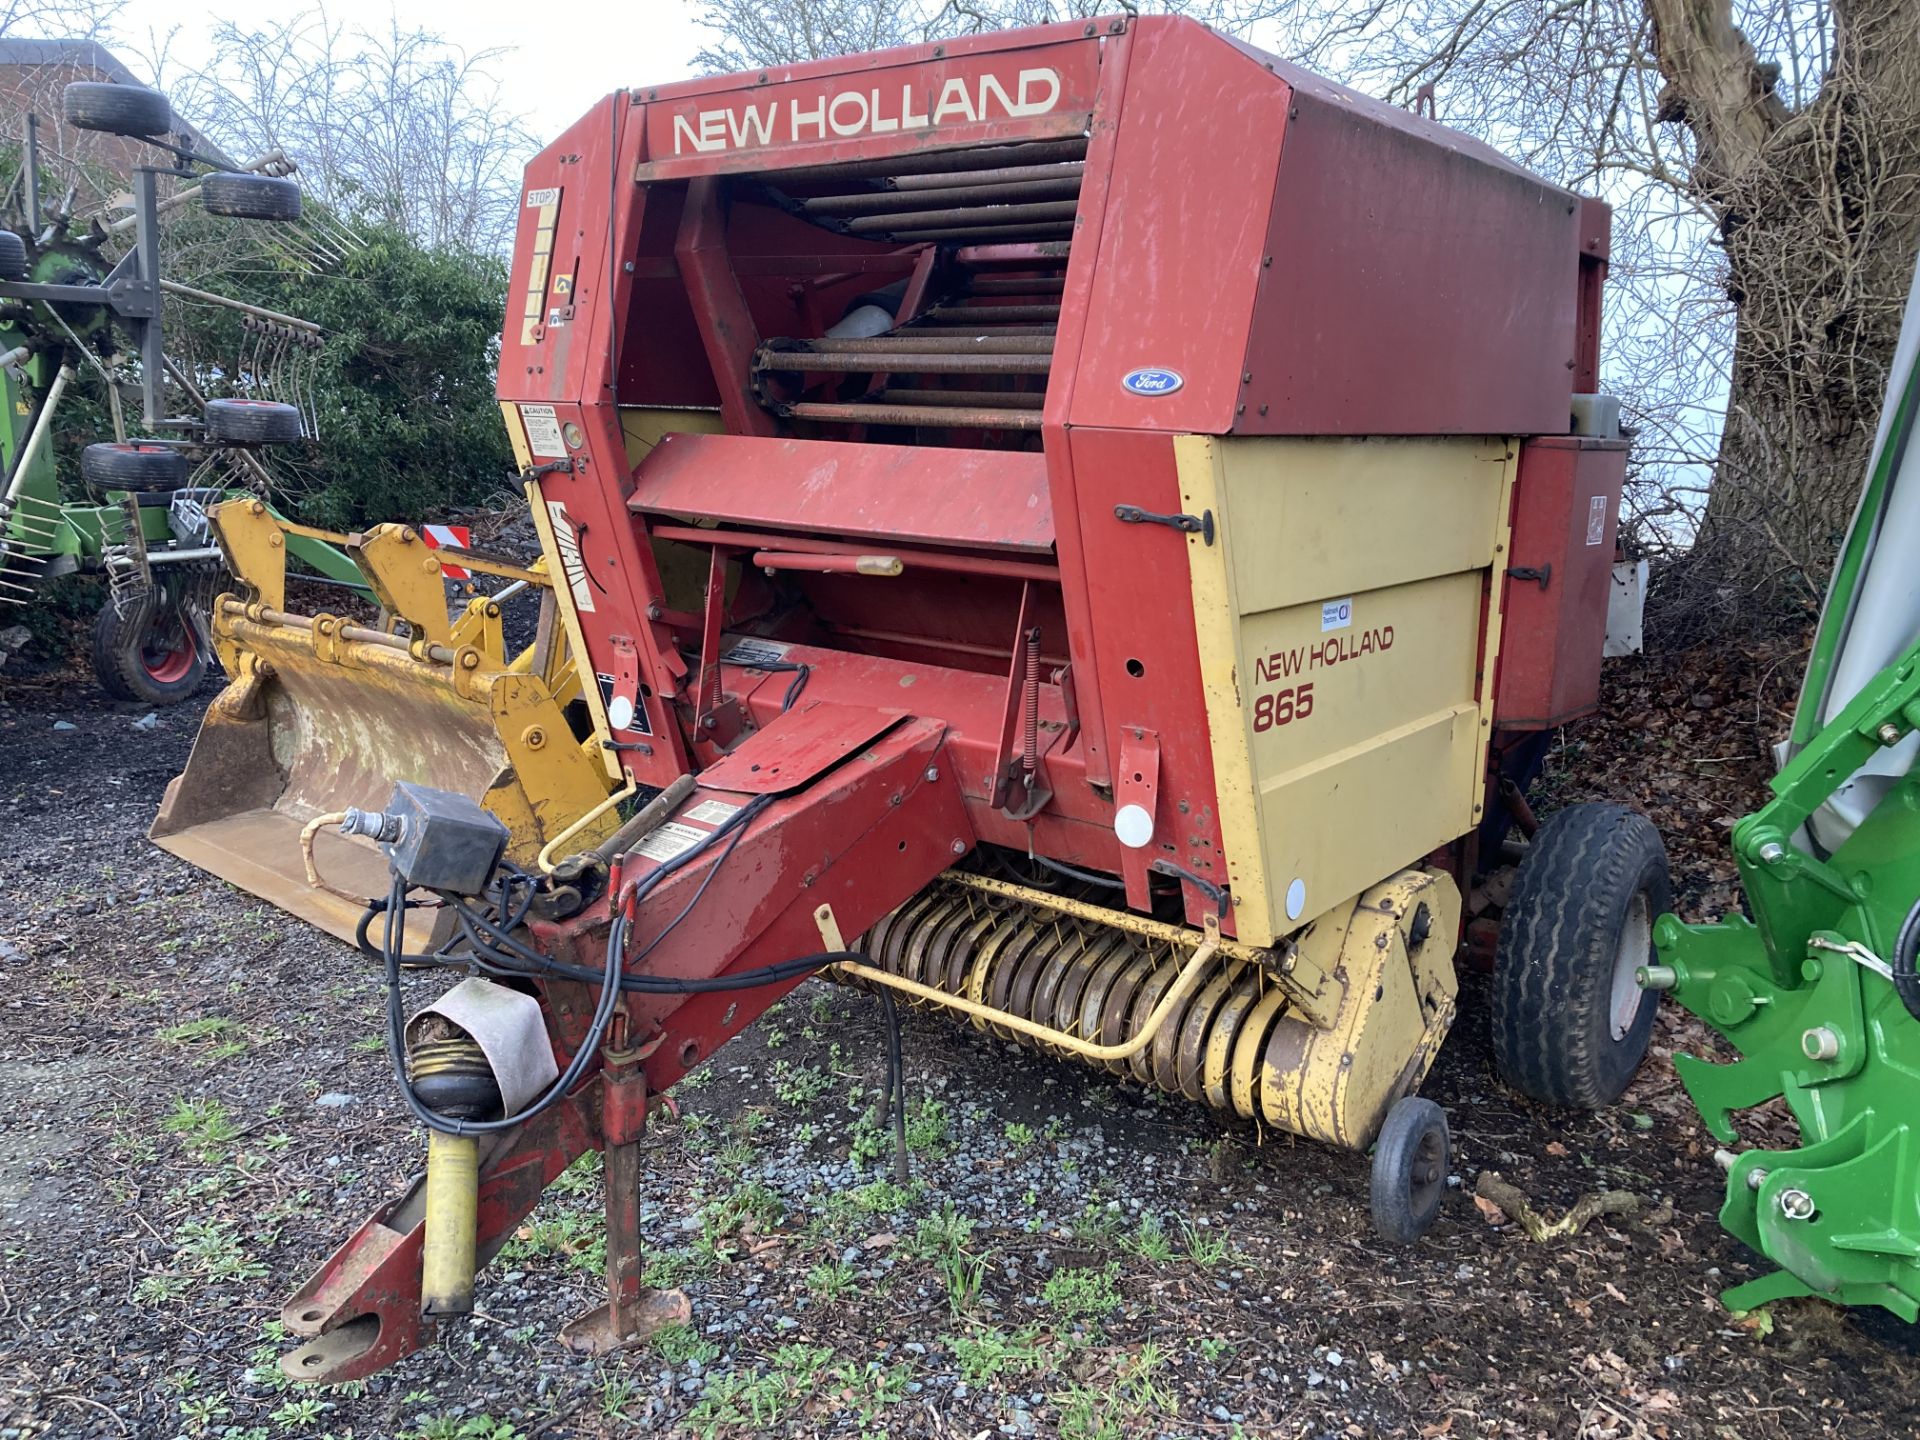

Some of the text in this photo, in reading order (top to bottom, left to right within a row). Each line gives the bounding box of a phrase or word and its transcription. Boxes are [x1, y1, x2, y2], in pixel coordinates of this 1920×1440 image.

[673, 67, 1061, 155] NEW HOLLAND
[528, 191, 552, 205] STOP
[1135, 372, 1168, 389] Ford
[528, 407, 553, 415] CAUTION
[1255, 625, 1394, 686] NEW HOLLAND
[1253, 682, 1314, 733] 865
